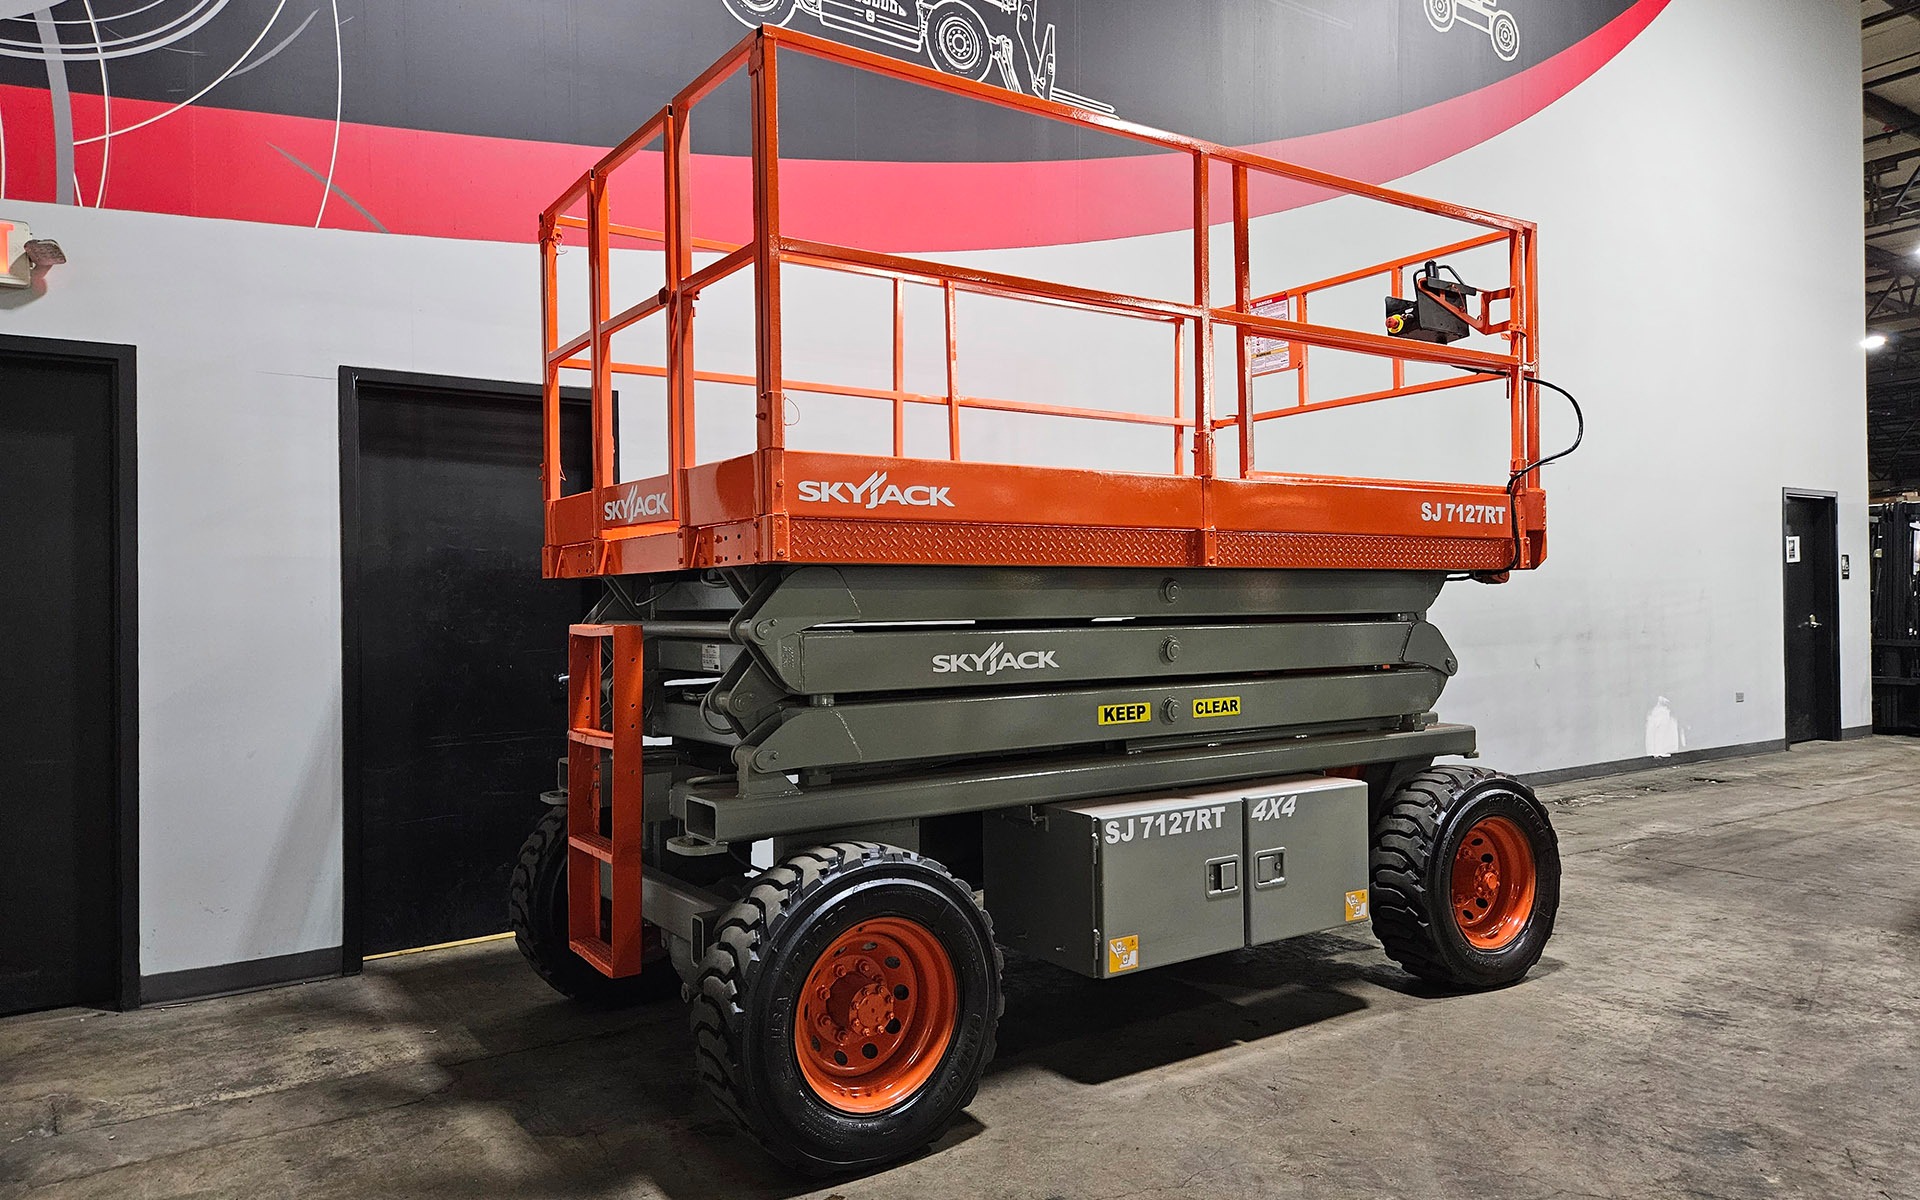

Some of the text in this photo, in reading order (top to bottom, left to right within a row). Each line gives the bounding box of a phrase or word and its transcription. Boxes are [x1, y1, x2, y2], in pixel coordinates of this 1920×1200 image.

[604, 485, 669, 523] SKYJACK
[798, 471, 955, 509] SKYJACK
[1421, 502, 1506, 524] SJ 7127RT
[933, 641, 1060, 676] SKYJACK
[1103, 700, 1238, 722] KEEP CLEAR
[1105, 806, 1226, 844] SJ 7127RT
[1251, 795, 1298, 821] 4X4
